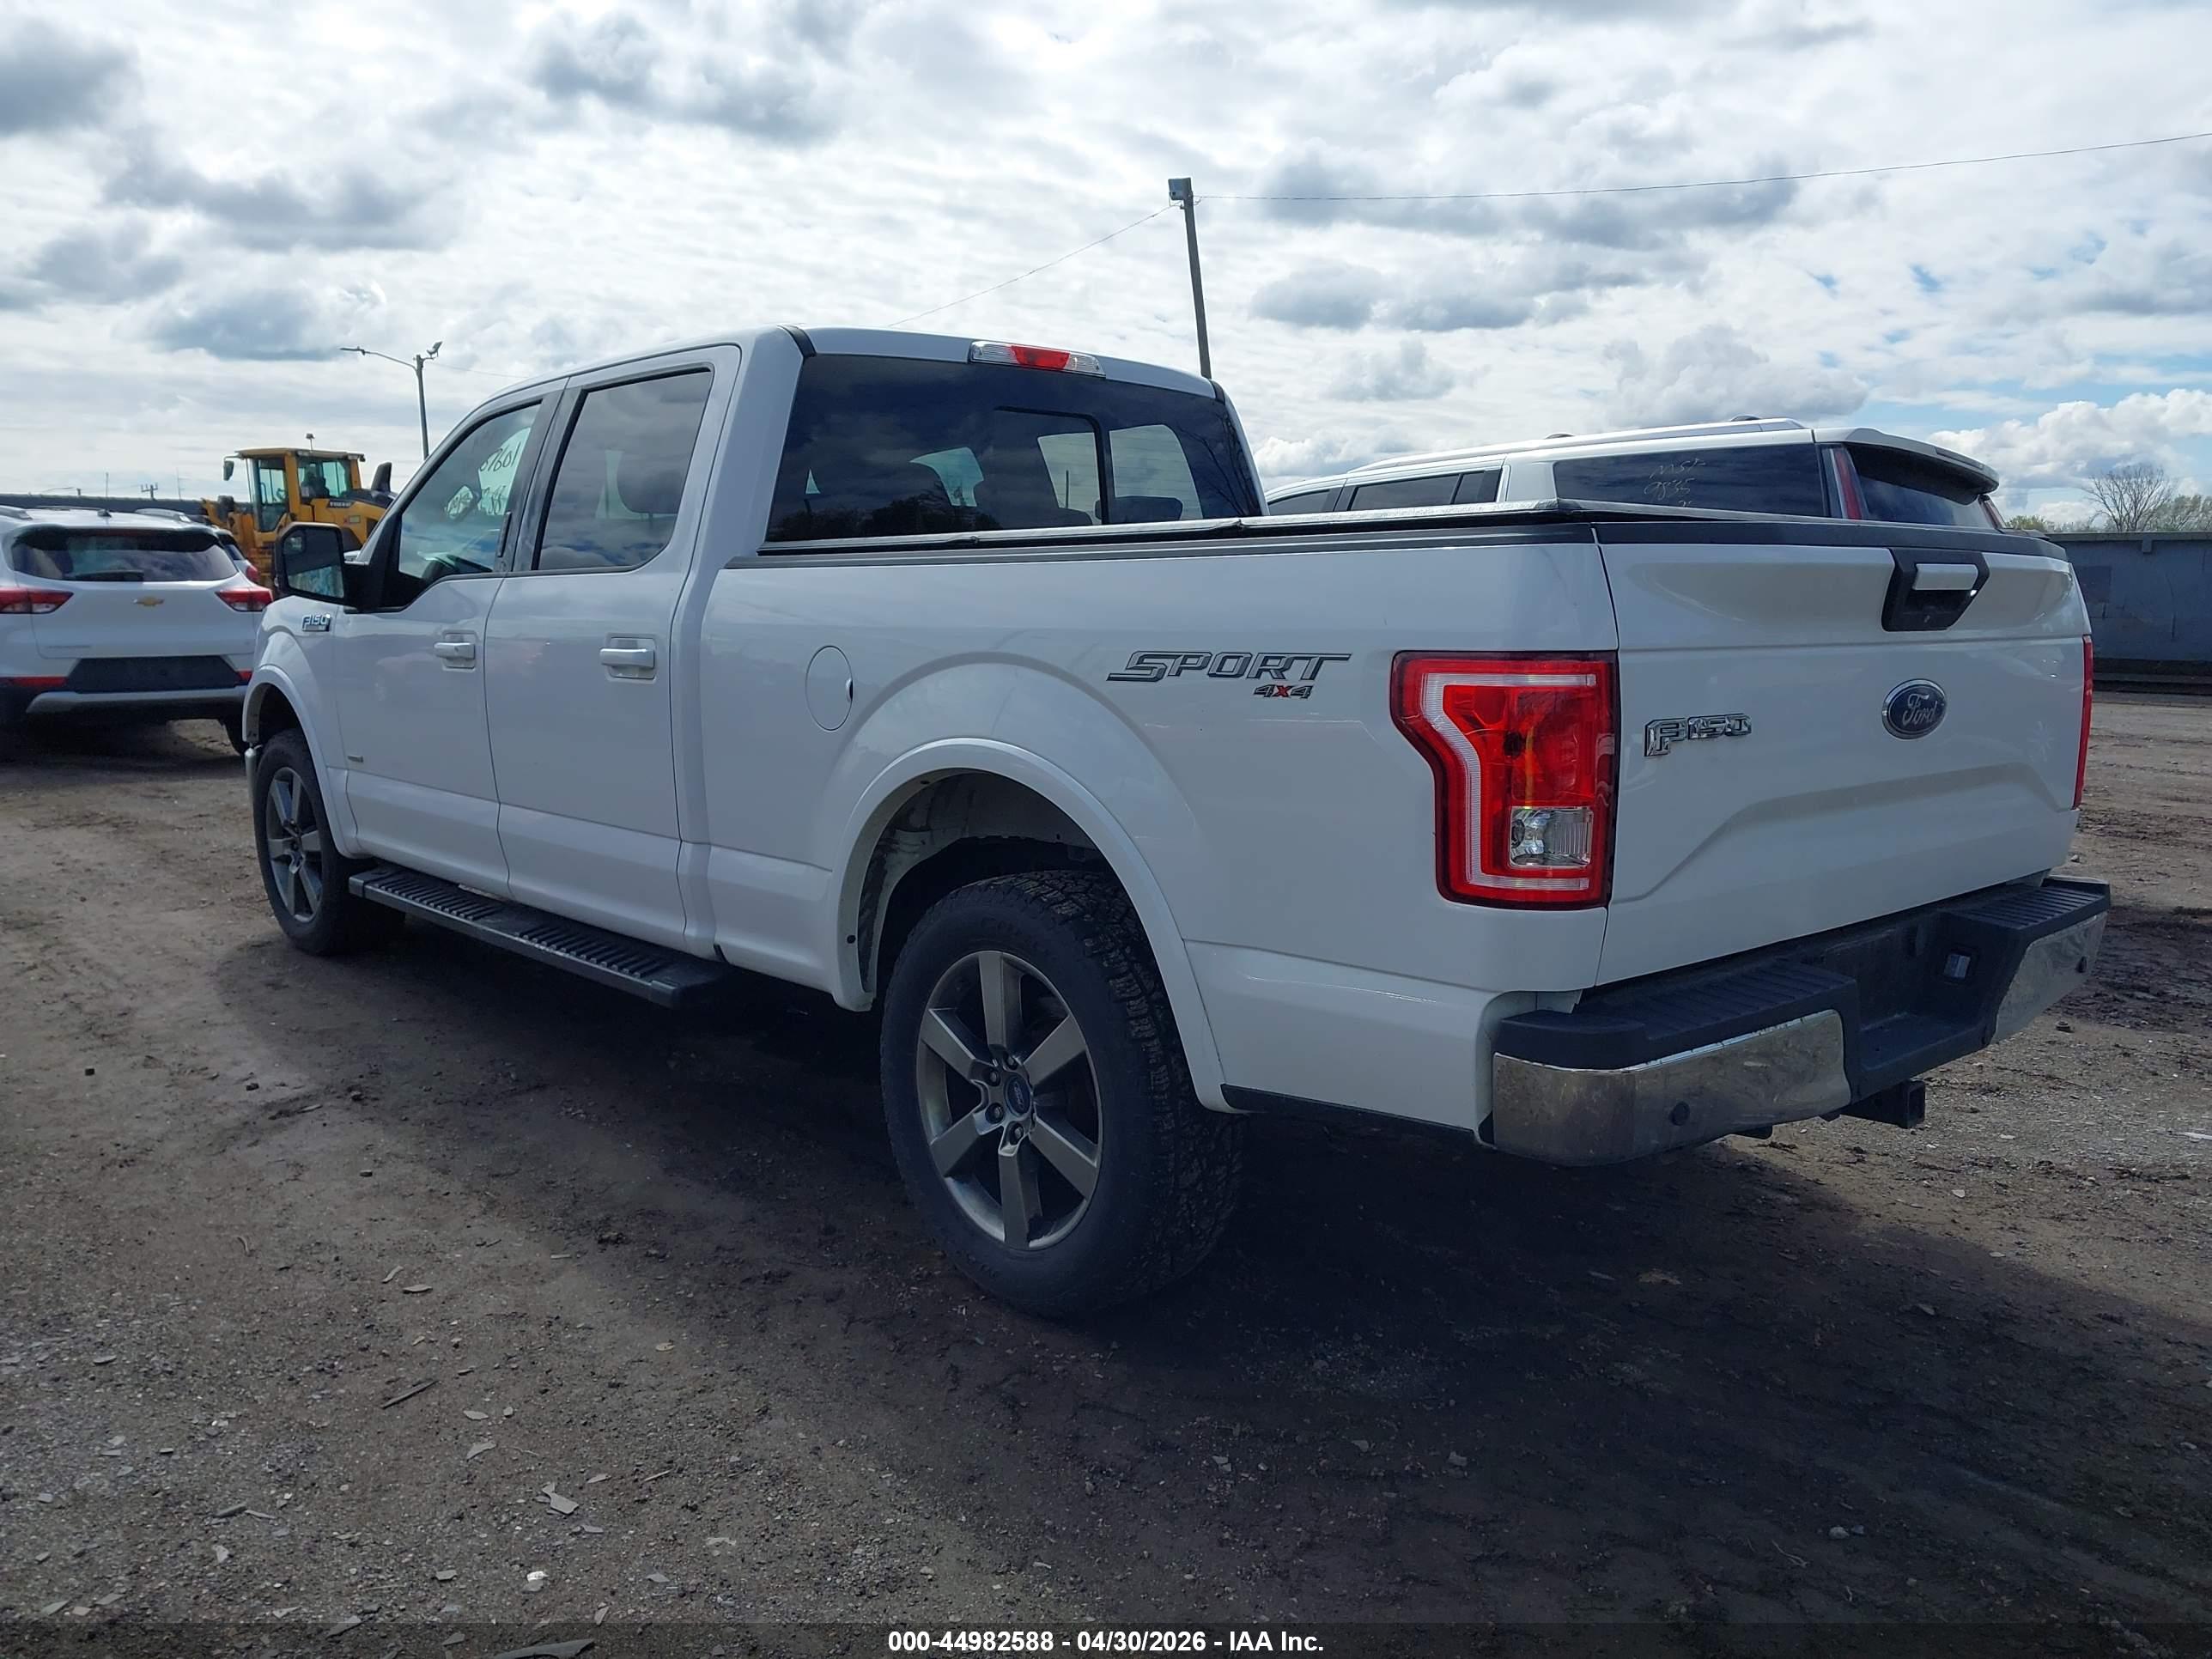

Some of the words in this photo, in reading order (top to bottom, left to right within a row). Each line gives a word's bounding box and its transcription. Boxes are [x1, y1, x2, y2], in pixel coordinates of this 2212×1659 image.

[1106, 651, 1352, 682] SPORT
[1902, 693, 1938, 726] Ford
[1644, 713, 1752, 757] F150
